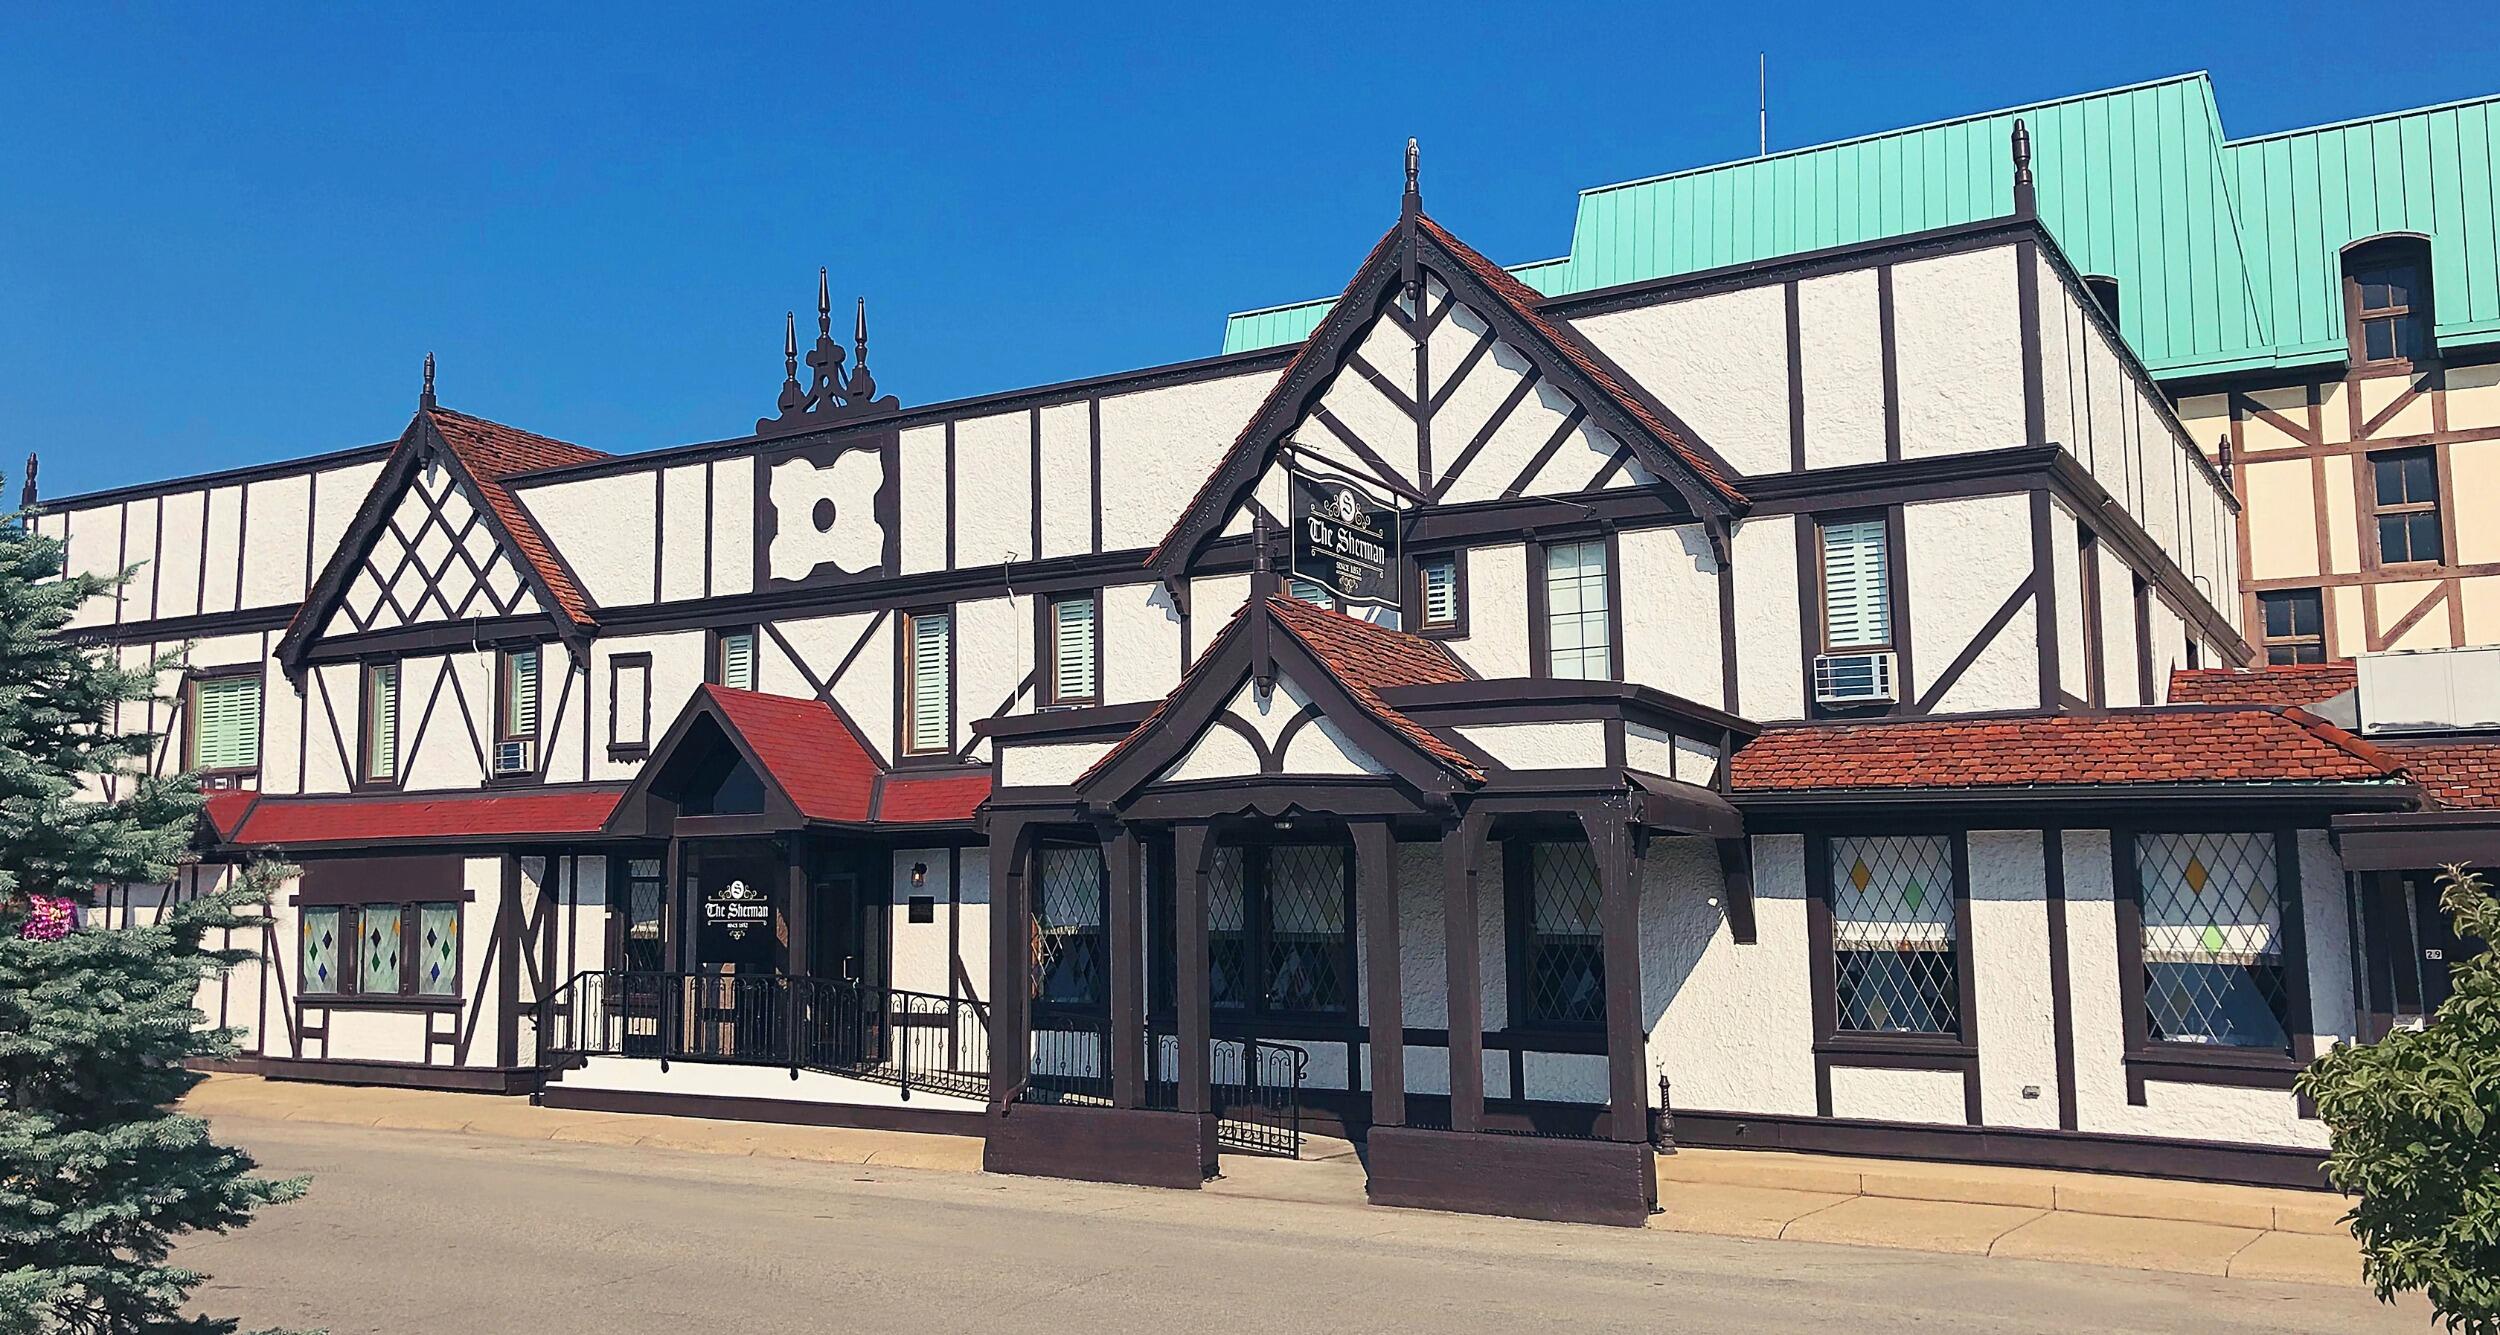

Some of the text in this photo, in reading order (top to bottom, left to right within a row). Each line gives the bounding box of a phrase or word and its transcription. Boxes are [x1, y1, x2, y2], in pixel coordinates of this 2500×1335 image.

[1343, 495, 1351, 515] S
[1308, 517, 1385, 565] The Sherman
[705, 903, 768, 919] The Sherman
